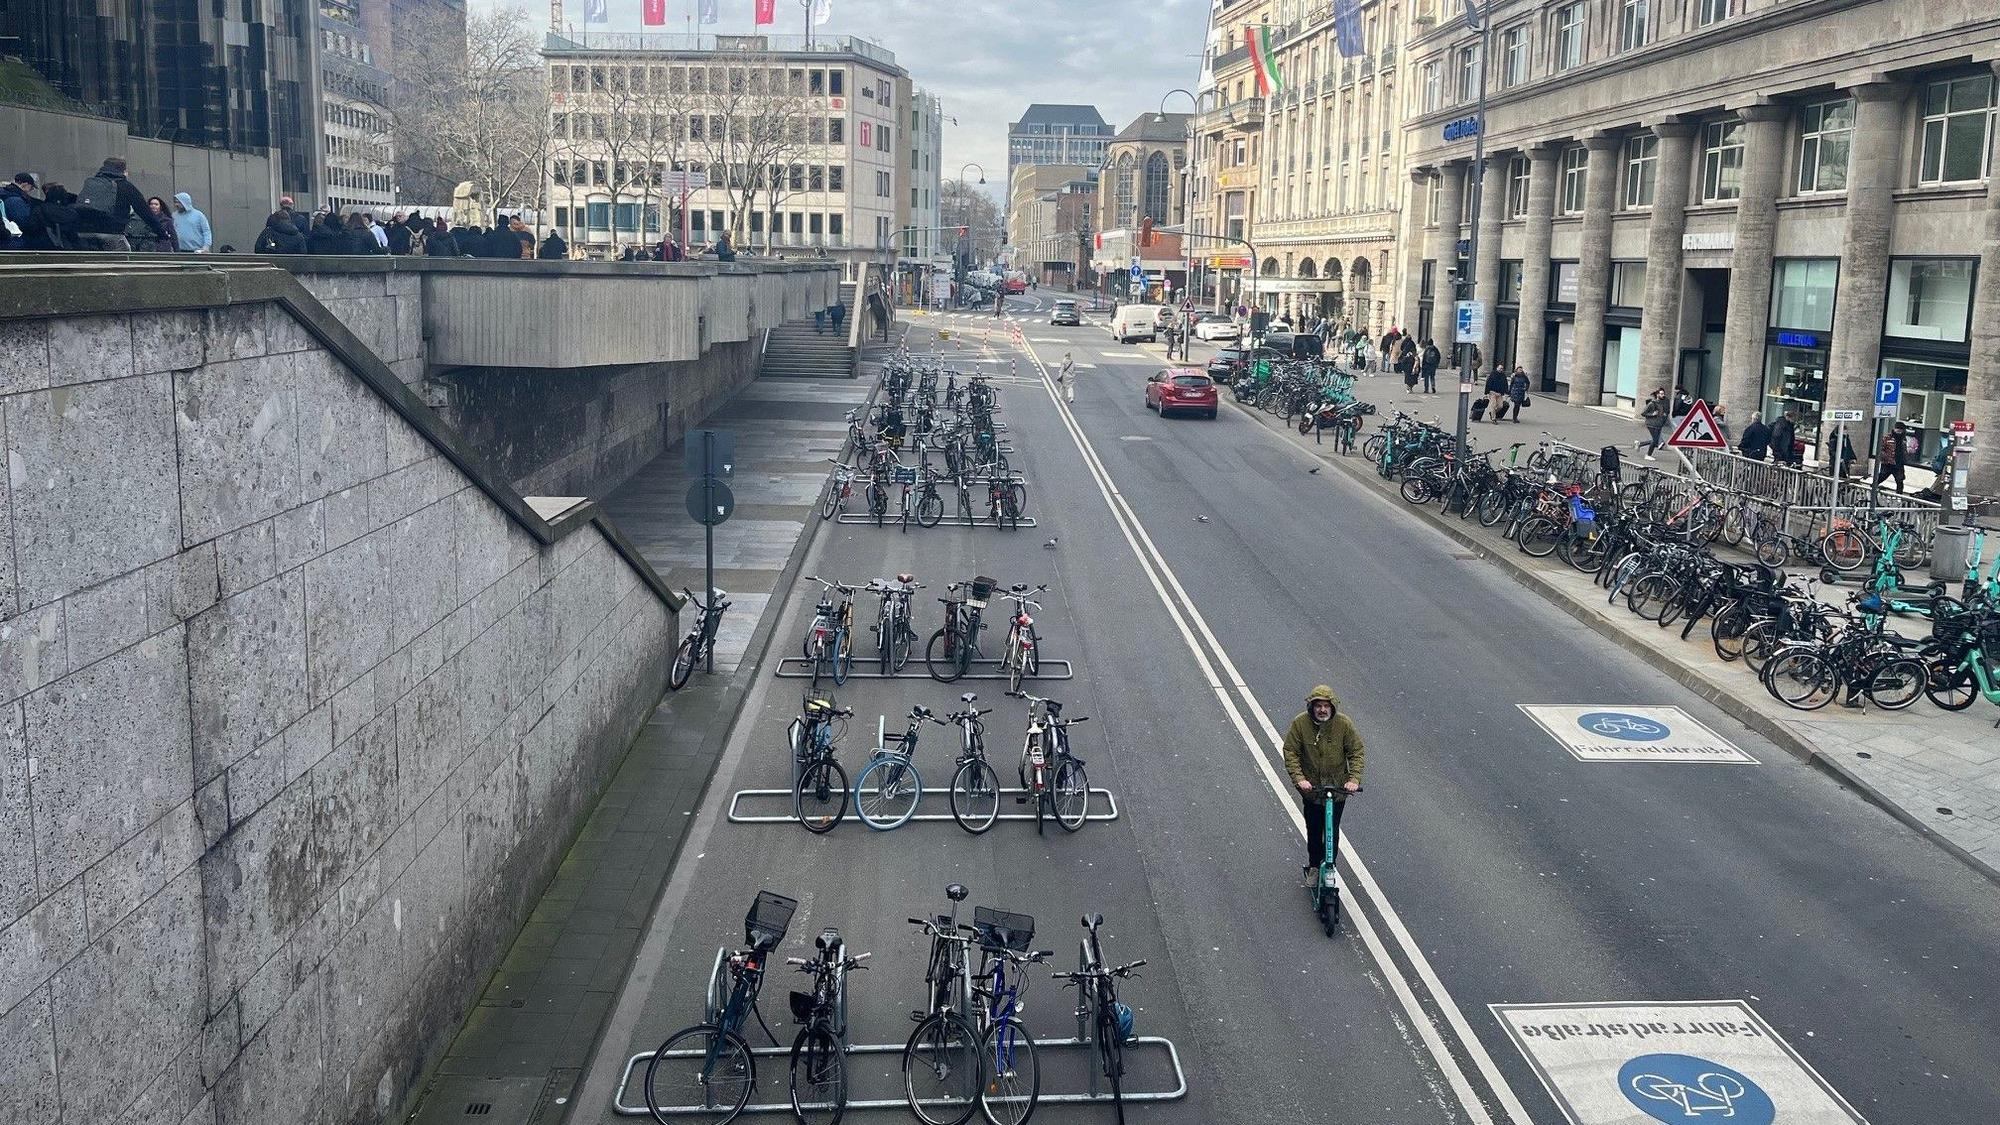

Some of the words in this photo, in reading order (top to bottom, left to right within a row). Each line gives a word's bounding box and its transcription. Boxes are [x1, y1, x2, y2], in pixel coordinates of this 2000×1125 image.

[1881, 382, 1895, 401] P
[1573, 744, 1733, 755] Fahrradstraße
[1522, 1021, 1763, 1041] Fahrradstraße
